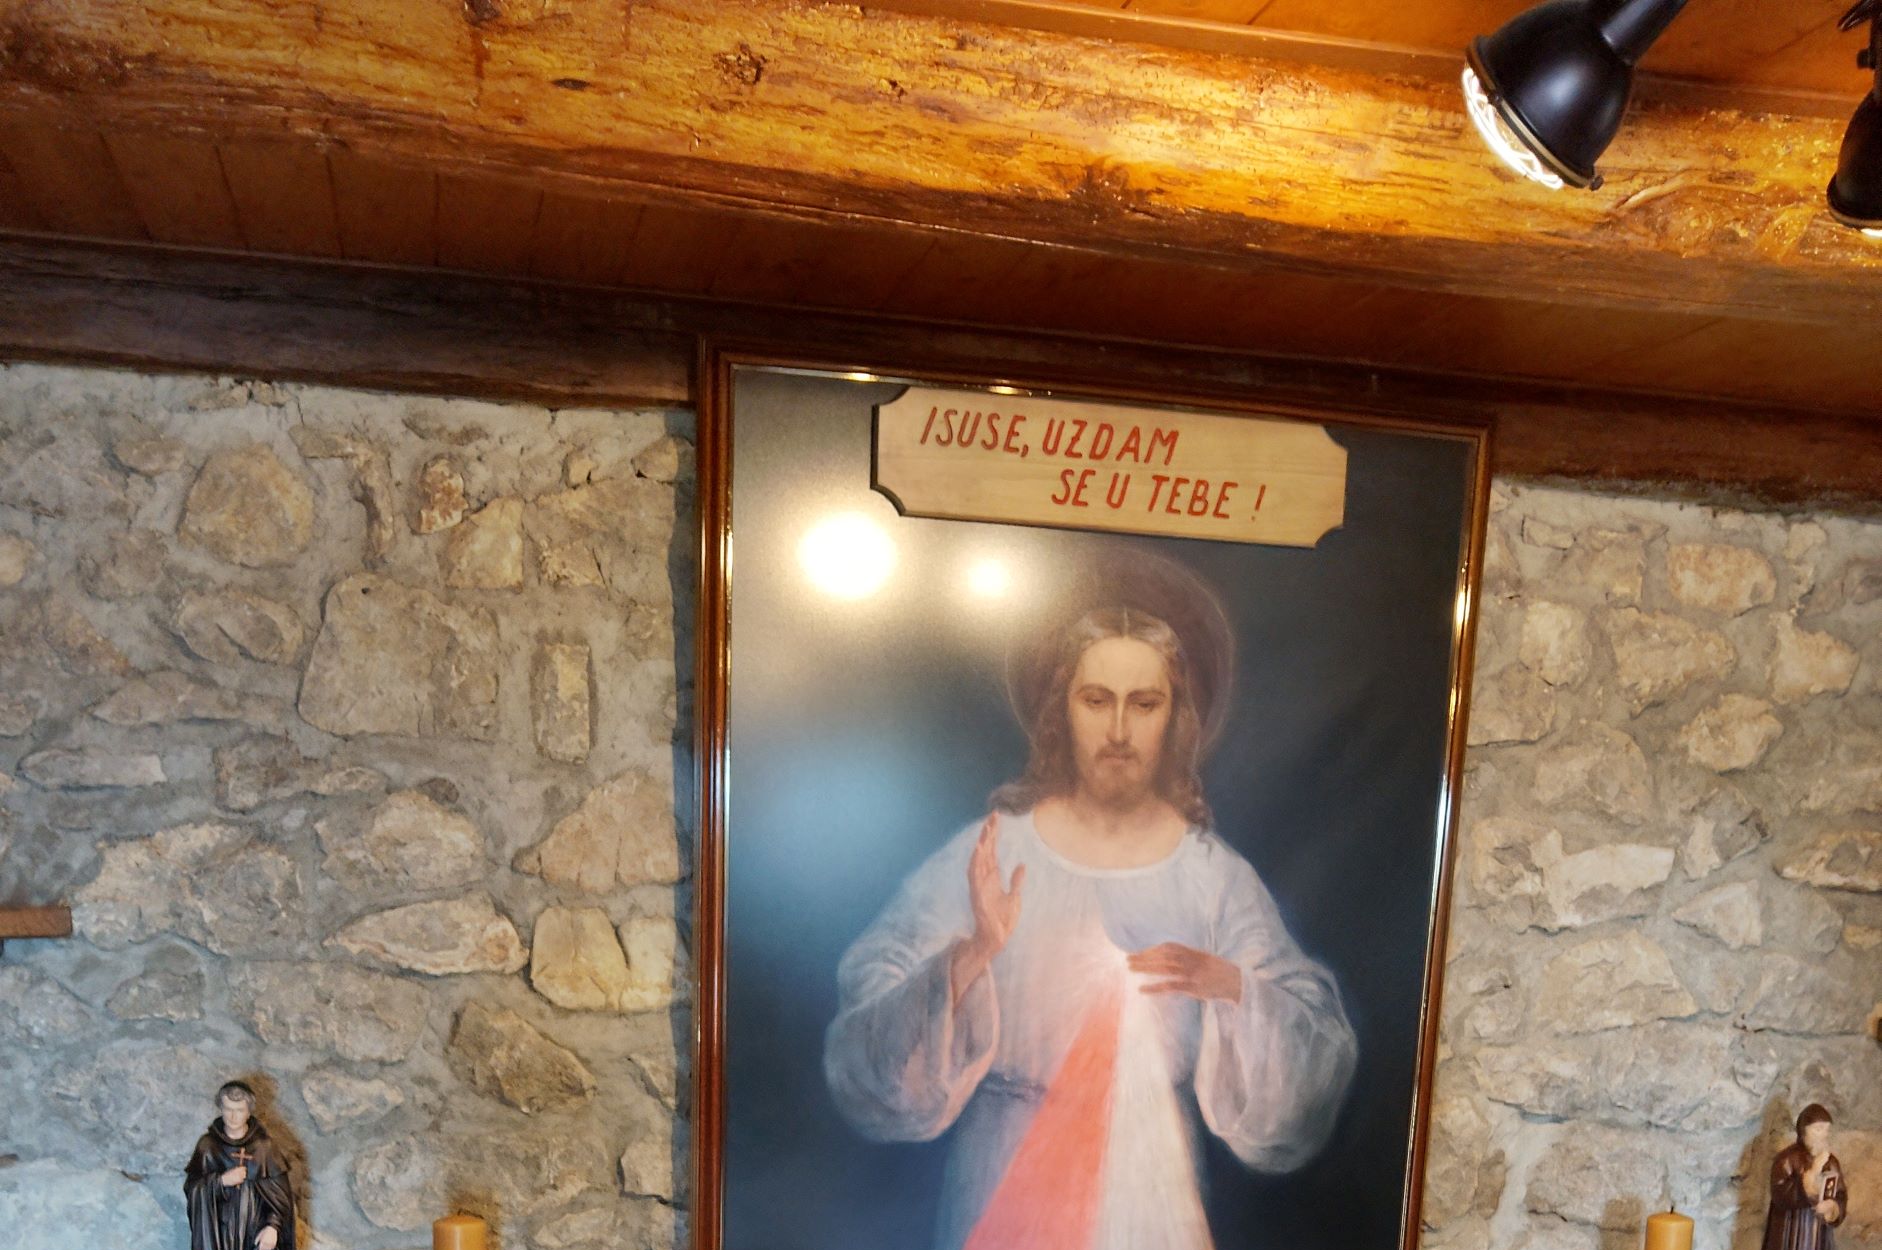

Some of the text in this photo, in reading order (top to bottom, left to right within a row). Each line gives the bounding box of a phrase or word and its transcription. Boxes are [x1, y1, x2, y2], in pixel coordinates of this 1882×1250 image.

[919, 406, 1180, 467] ISUSE, UZDAM
[1051, 469, 1096, 507] SE
[1105, 472, 1131, 510] U
[1147, 474, 1239, 520] TEBE
